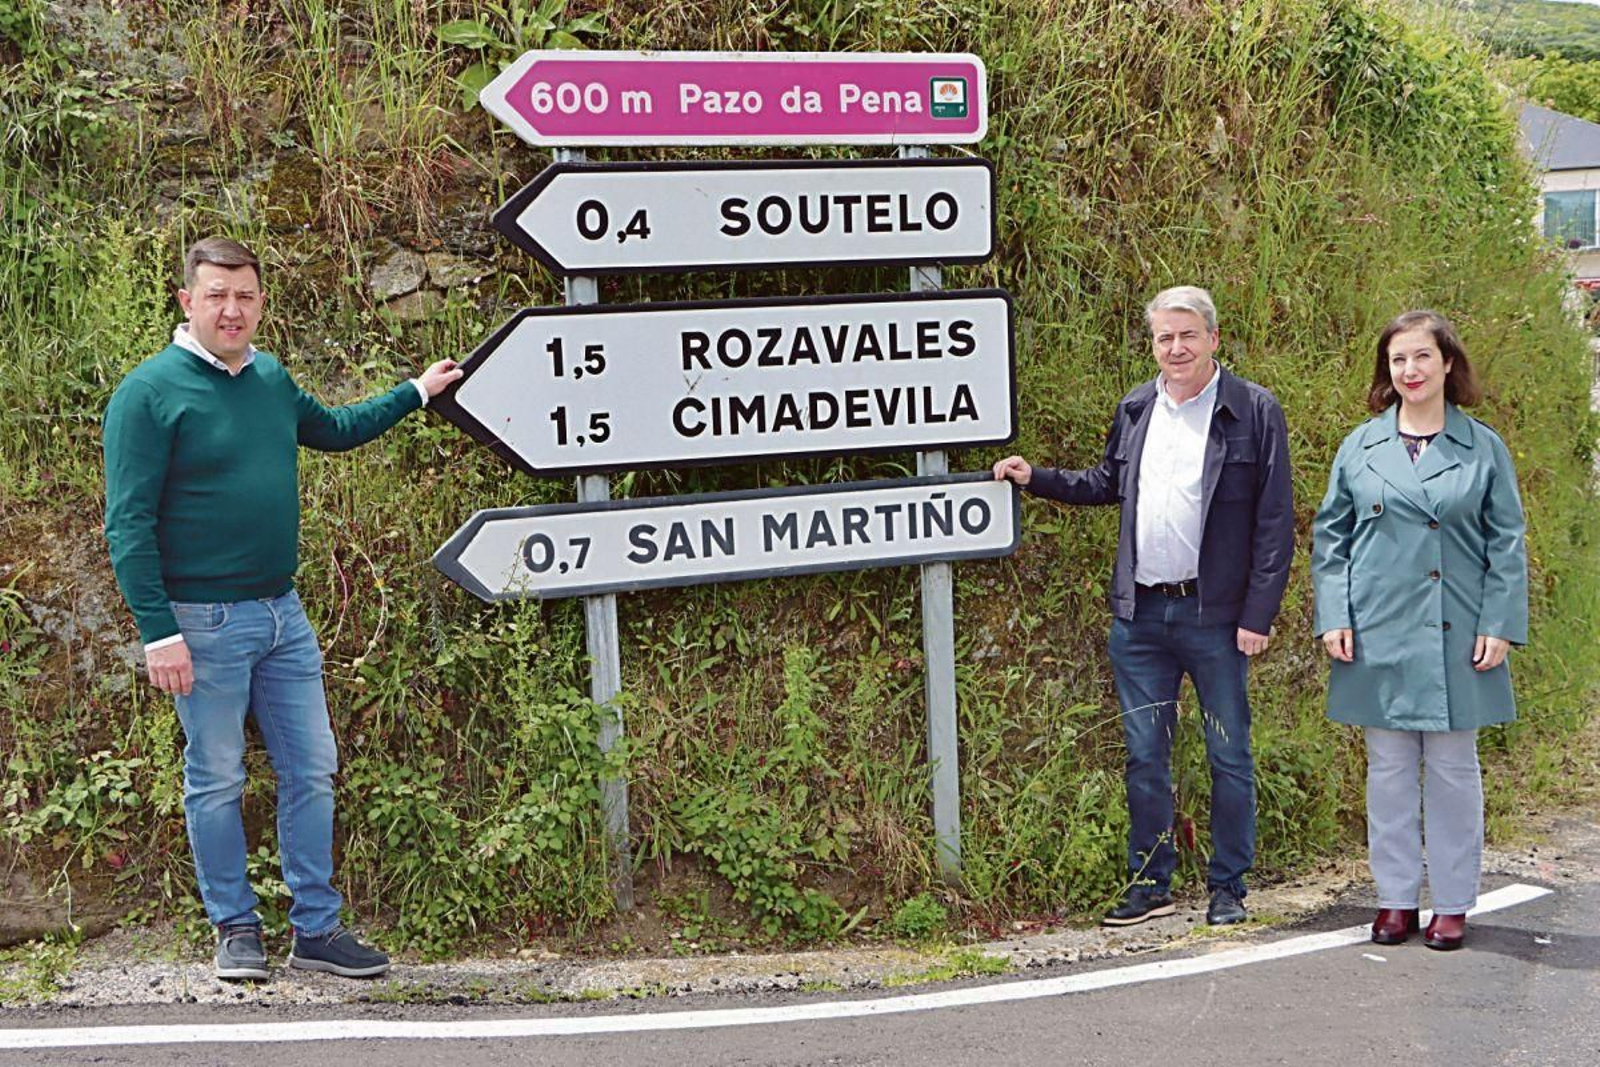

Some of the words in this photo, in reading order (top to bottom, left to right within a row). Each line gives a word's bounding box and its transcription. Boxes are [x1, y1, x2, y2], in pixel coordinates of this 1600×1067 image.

[530, 82, 609, 115] 600
[621, 92, 653, 114] m
[680, 84, 763, 114] Pazo
[781, 85, 823, 114] da
[839, 84, 923, 114] Pena
[576, 199, 652, 244] 0,4
[720, 191, 959, 236] SOUTELO
[546, 338, 607, 380] 1,5
[681, 320, 976, 371] ROZAVALES
[550, 406, 611, 447] 1,5
[672, 384, 980, 438] CIMADEVILA
[522, 532, 592, 575] 0,7
[627, 517, 735, 566] SAN
[763, 492, 992, 552] MARTIÑO
